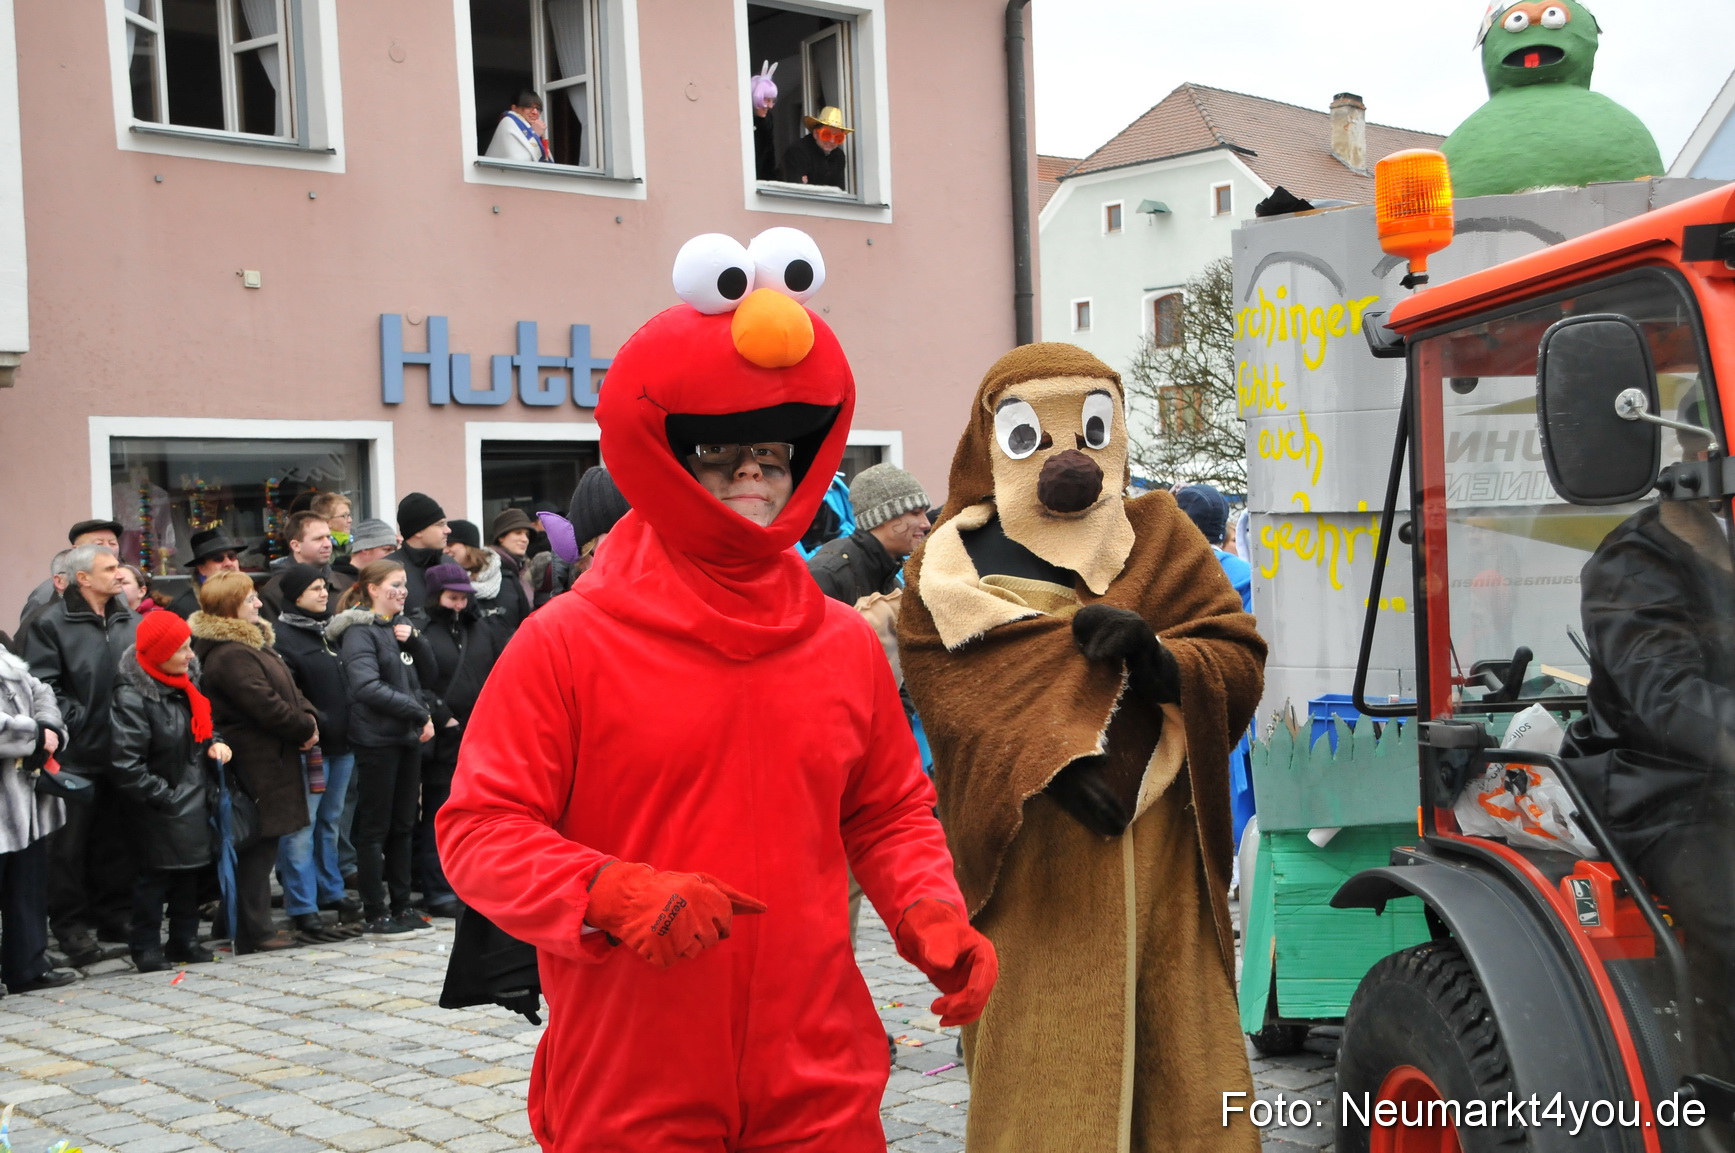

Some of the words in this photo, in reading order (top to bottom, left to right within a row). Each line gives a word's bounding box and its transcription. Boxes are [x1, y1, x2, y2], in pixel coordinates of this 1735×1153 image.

[1257, 409, 1324, 487] euch
[1260, 513, 1389, 591] geehrt
[657, 897, 688, 937] Rexroth
